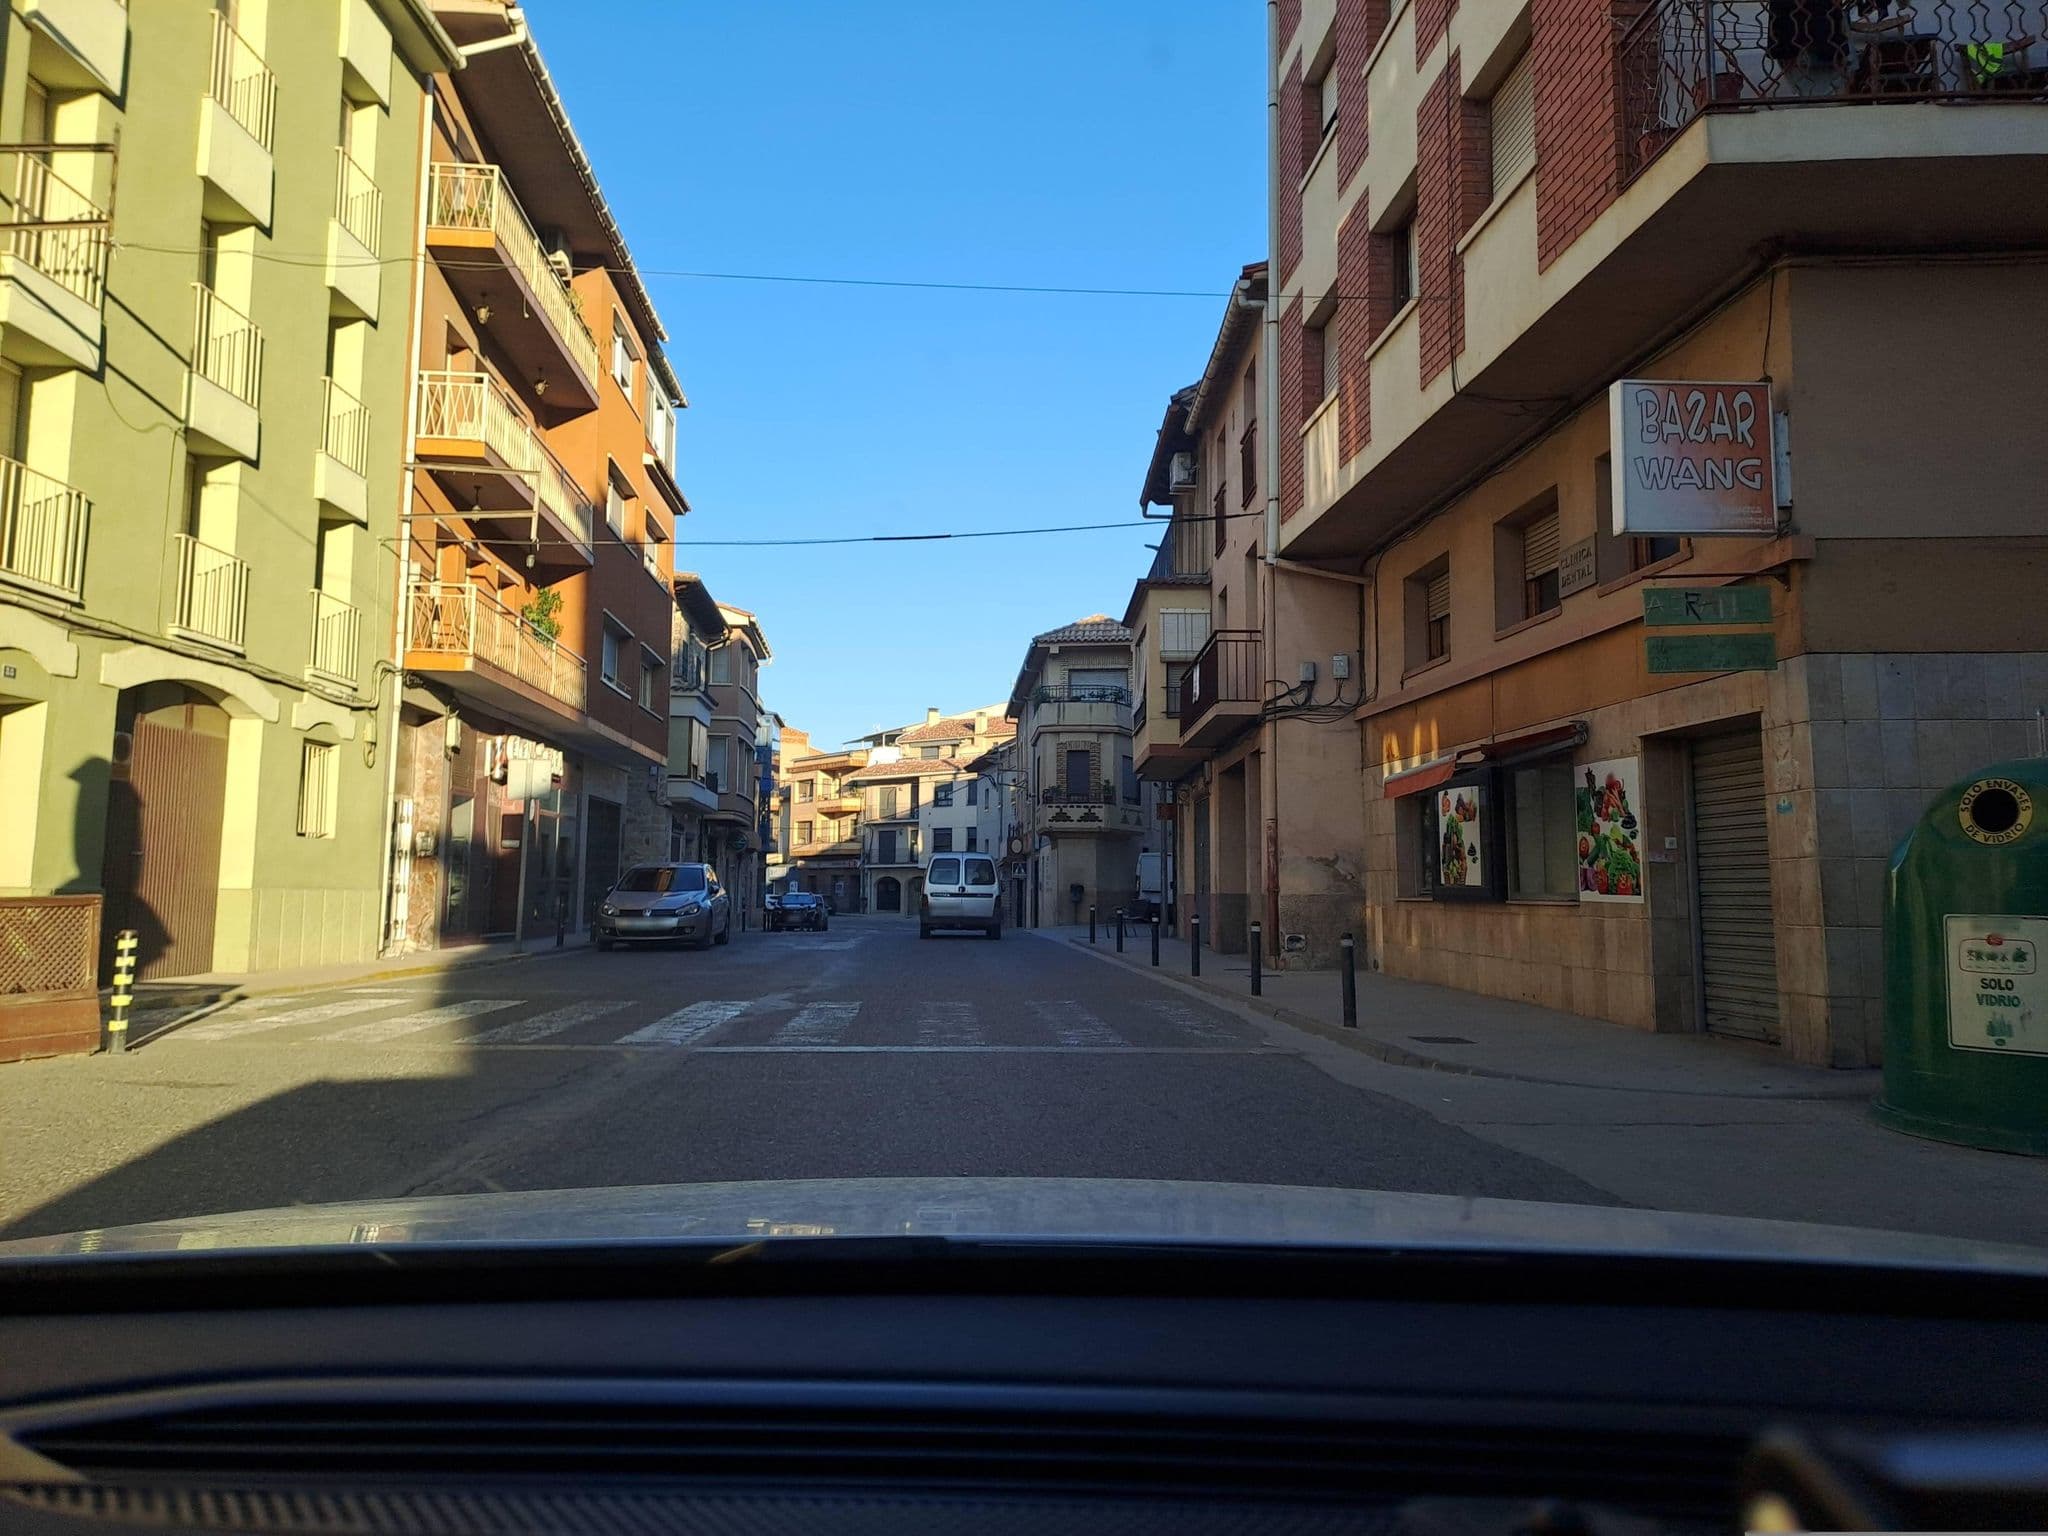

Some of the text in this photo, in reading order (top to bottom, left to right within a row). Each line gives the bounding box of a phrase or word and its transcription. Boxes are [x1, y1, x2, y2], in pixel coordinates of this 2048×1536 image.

[1635, 388, 1756, 449] BAZAR
[1633, 456, 1763, 491] WANG
[1561, 564, 1593, 588] DENTAL
[1960, 780, 2031, 813] SOLO ENVASES
[1965, 823, 2024, 843] DE VIDRIO
[1980, 978, 2015, 991] SOLO
[1976, 993, 2021, 1008] VIDRIO
